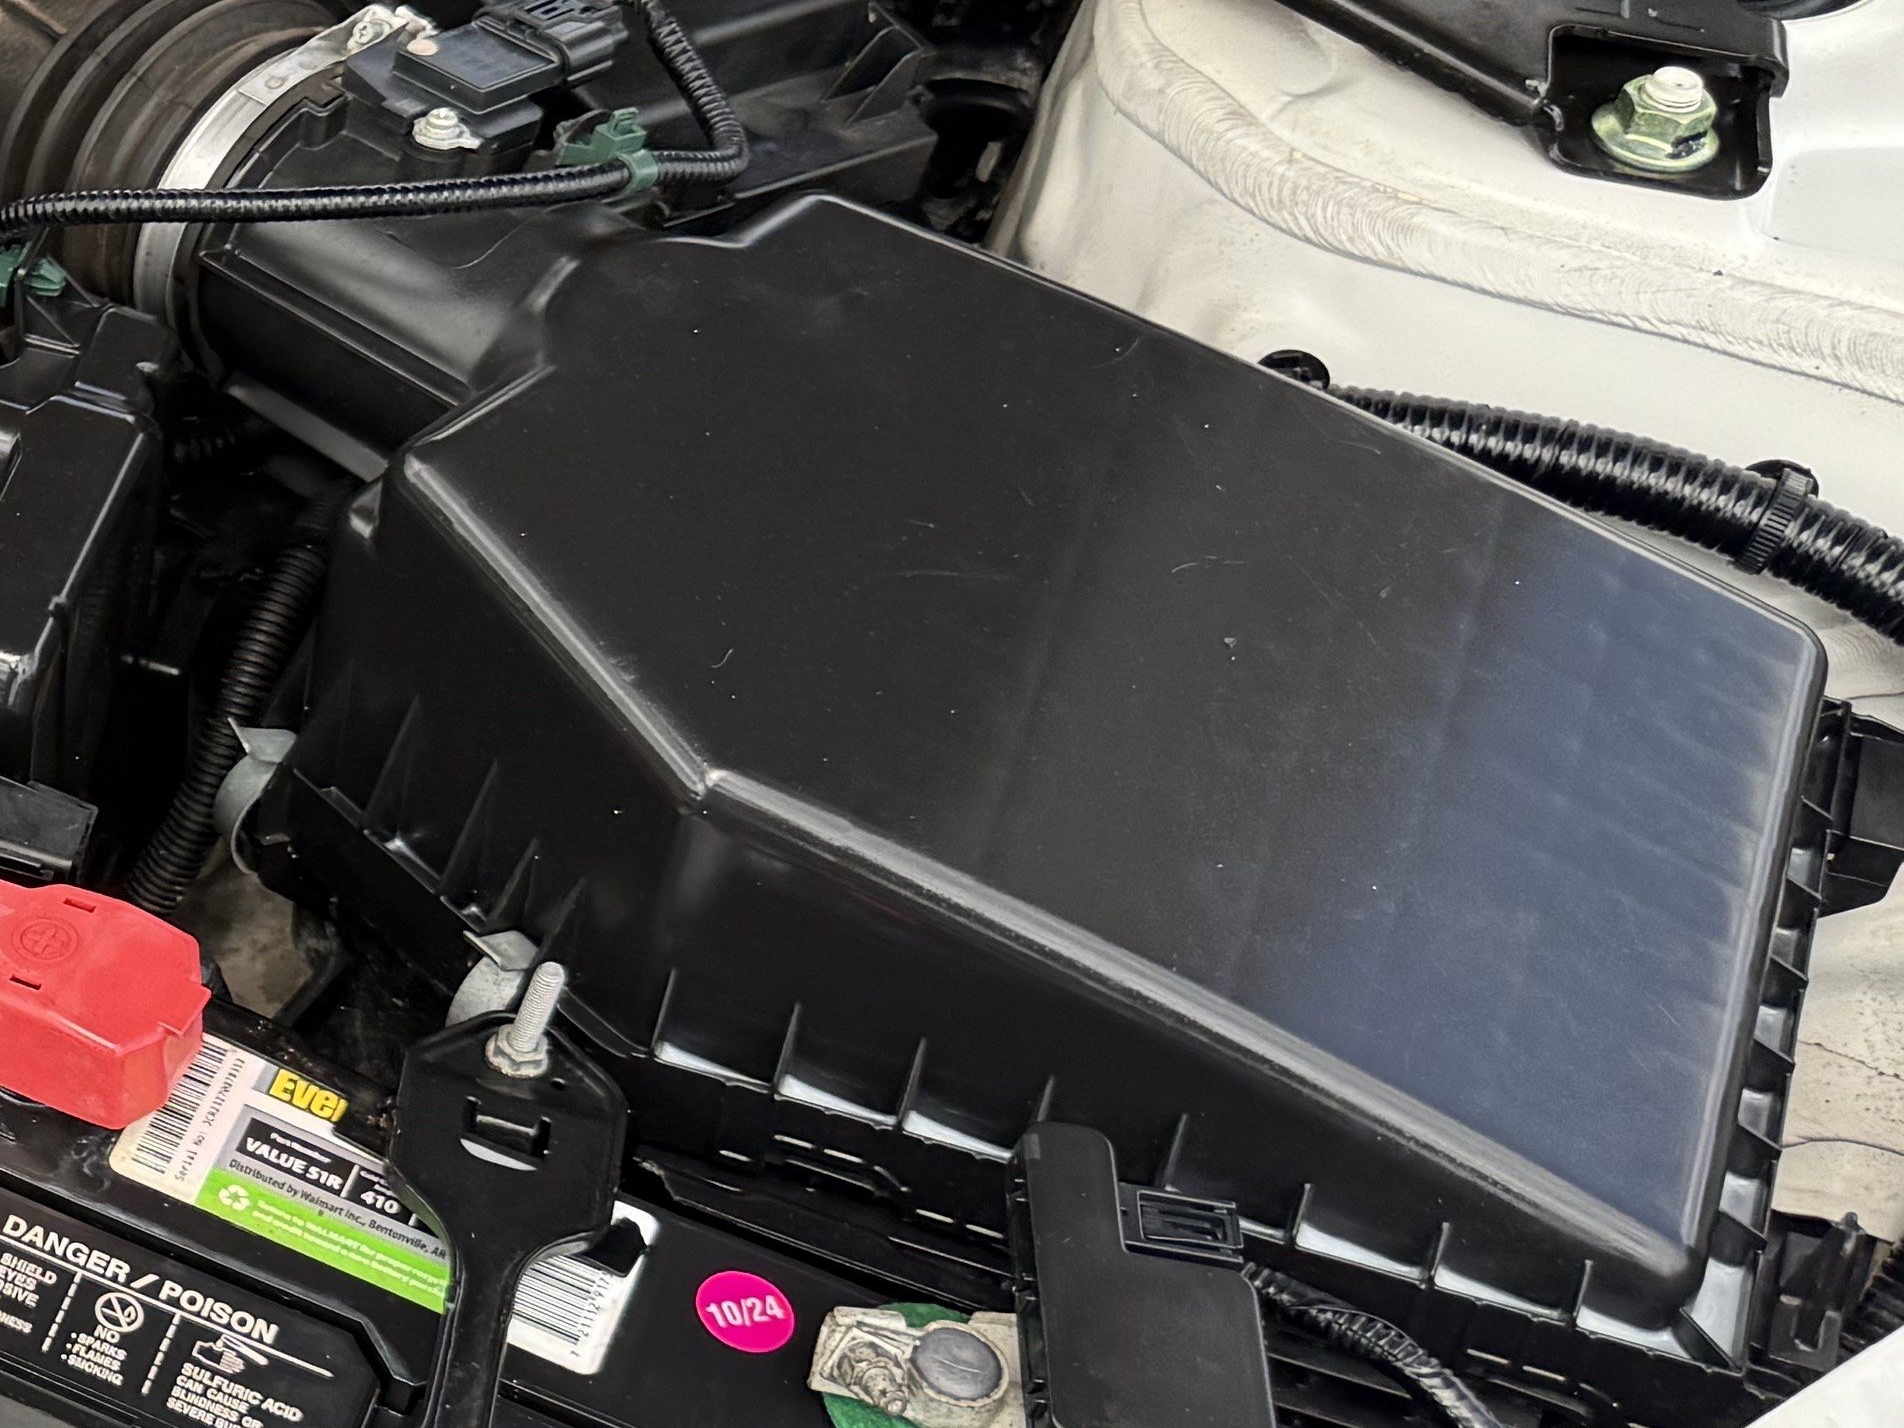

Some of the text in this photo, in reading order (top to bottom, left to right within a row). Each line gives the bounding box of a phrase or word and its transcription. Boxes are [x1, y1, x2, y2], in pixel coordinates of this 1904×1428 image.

[245, 1136, 308, 1178] VALUE
[305, 1165, 344, 1191] 51R
[229, 1159, 286, 1191] Distributed
[286, 1183, 301, 1199] by
[301, 1188, 345, 1216] Walmart
[368, 1219, 429, 1253] Bentonville,
[360, 1190, 402, 1215] 410
[0, 1252, 58, 1285] SHIELD
[2, 1217, 131, 1283] DANGER
[160, 1280, 280, 1346] POISON
[705, 1295, 785, 1329] 10/24
[77, 1333, 128, 1360] SPARKS
[94, 1325, 121, 1345] NO
[67, 1354, 123, 1386] SMOKING
[72, 1343, 122, 1371] FLAMES
[171, 1386, 240, 1422] BLINDNESS
[176, 1375, 250, 1415] CAN CAUSE
[181, 1362, 303, 1423] SULFURIC ACID
[166, 1397, 212, 1426] SEVERE
